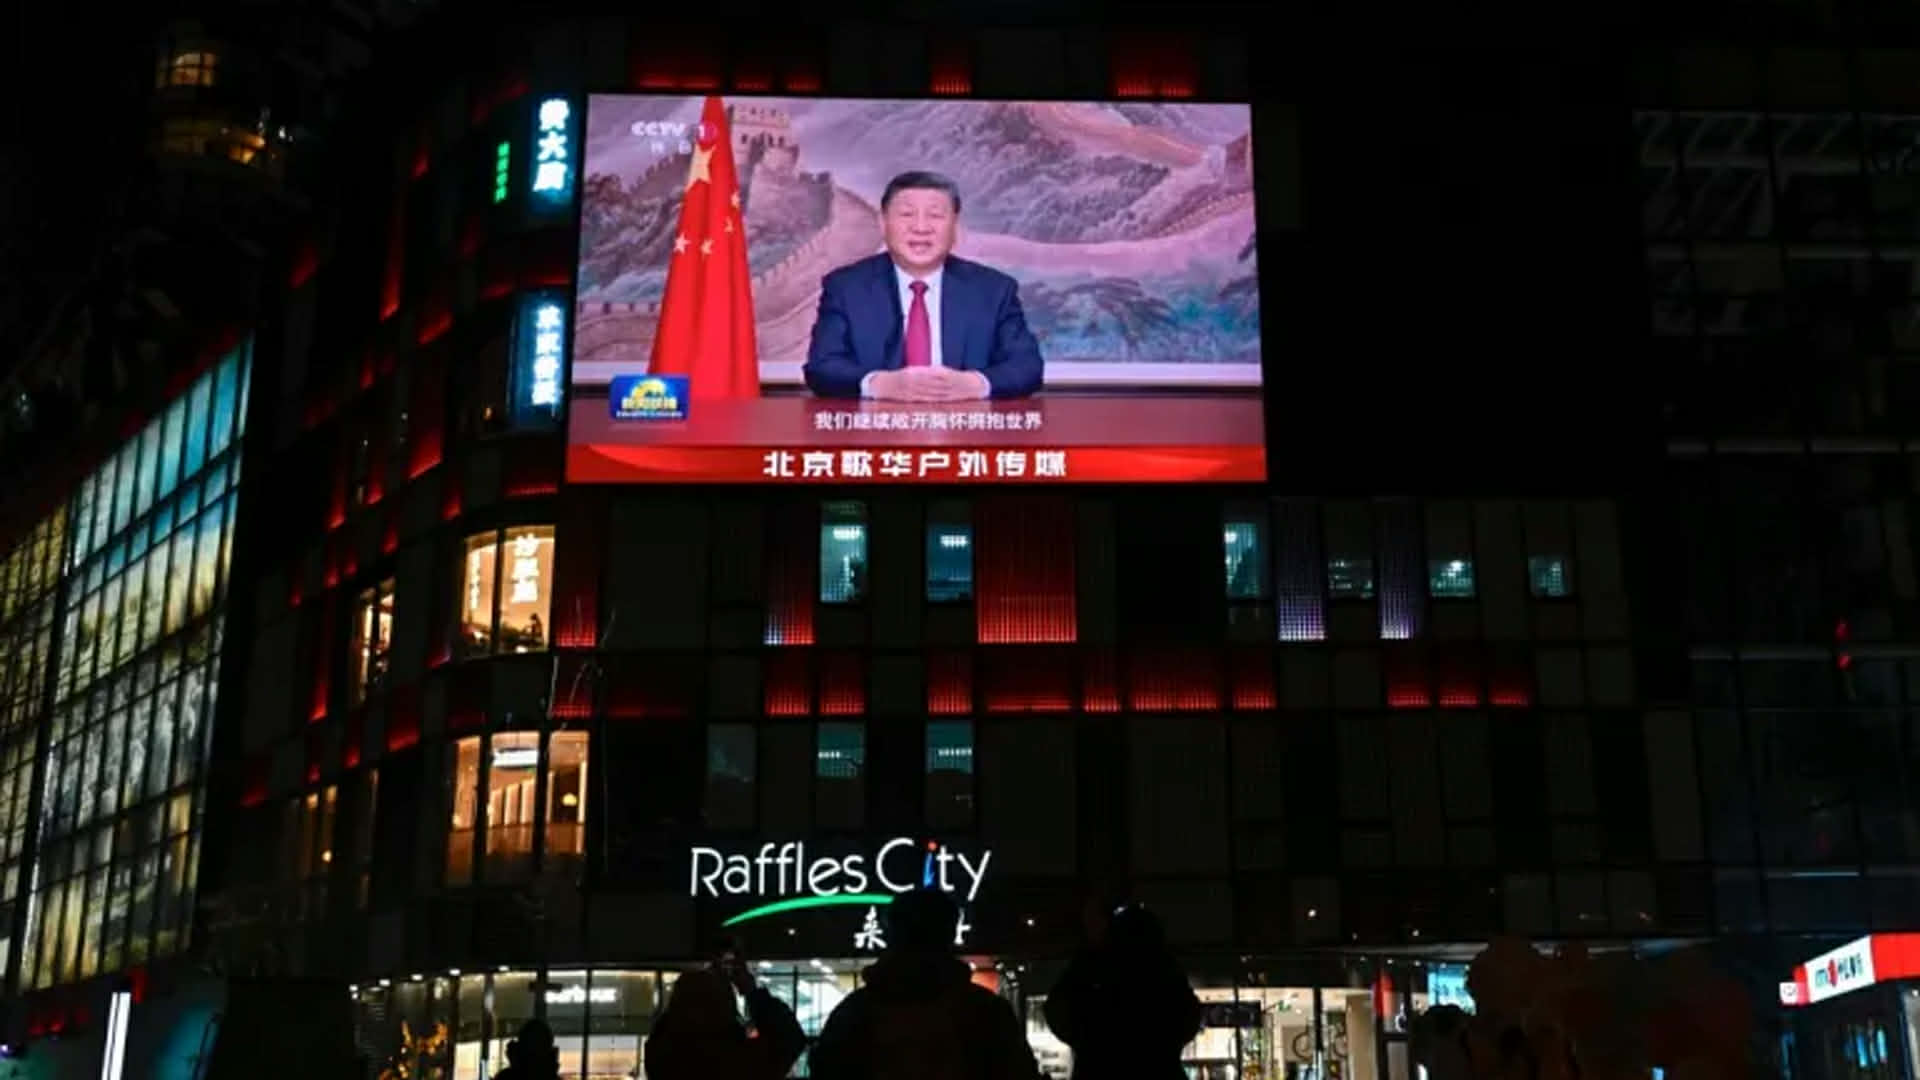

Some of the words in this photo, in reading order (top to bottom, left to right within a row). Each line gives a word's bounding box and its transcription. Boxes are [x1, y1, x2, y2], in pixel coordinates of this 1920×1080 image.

[631, 121, 686, 137] CCTV
[763, 450, 1067, 477] 北京歌华户外传媒
[690, 841, 868, 897] Raffles
[875, 837, 992, 902] City
